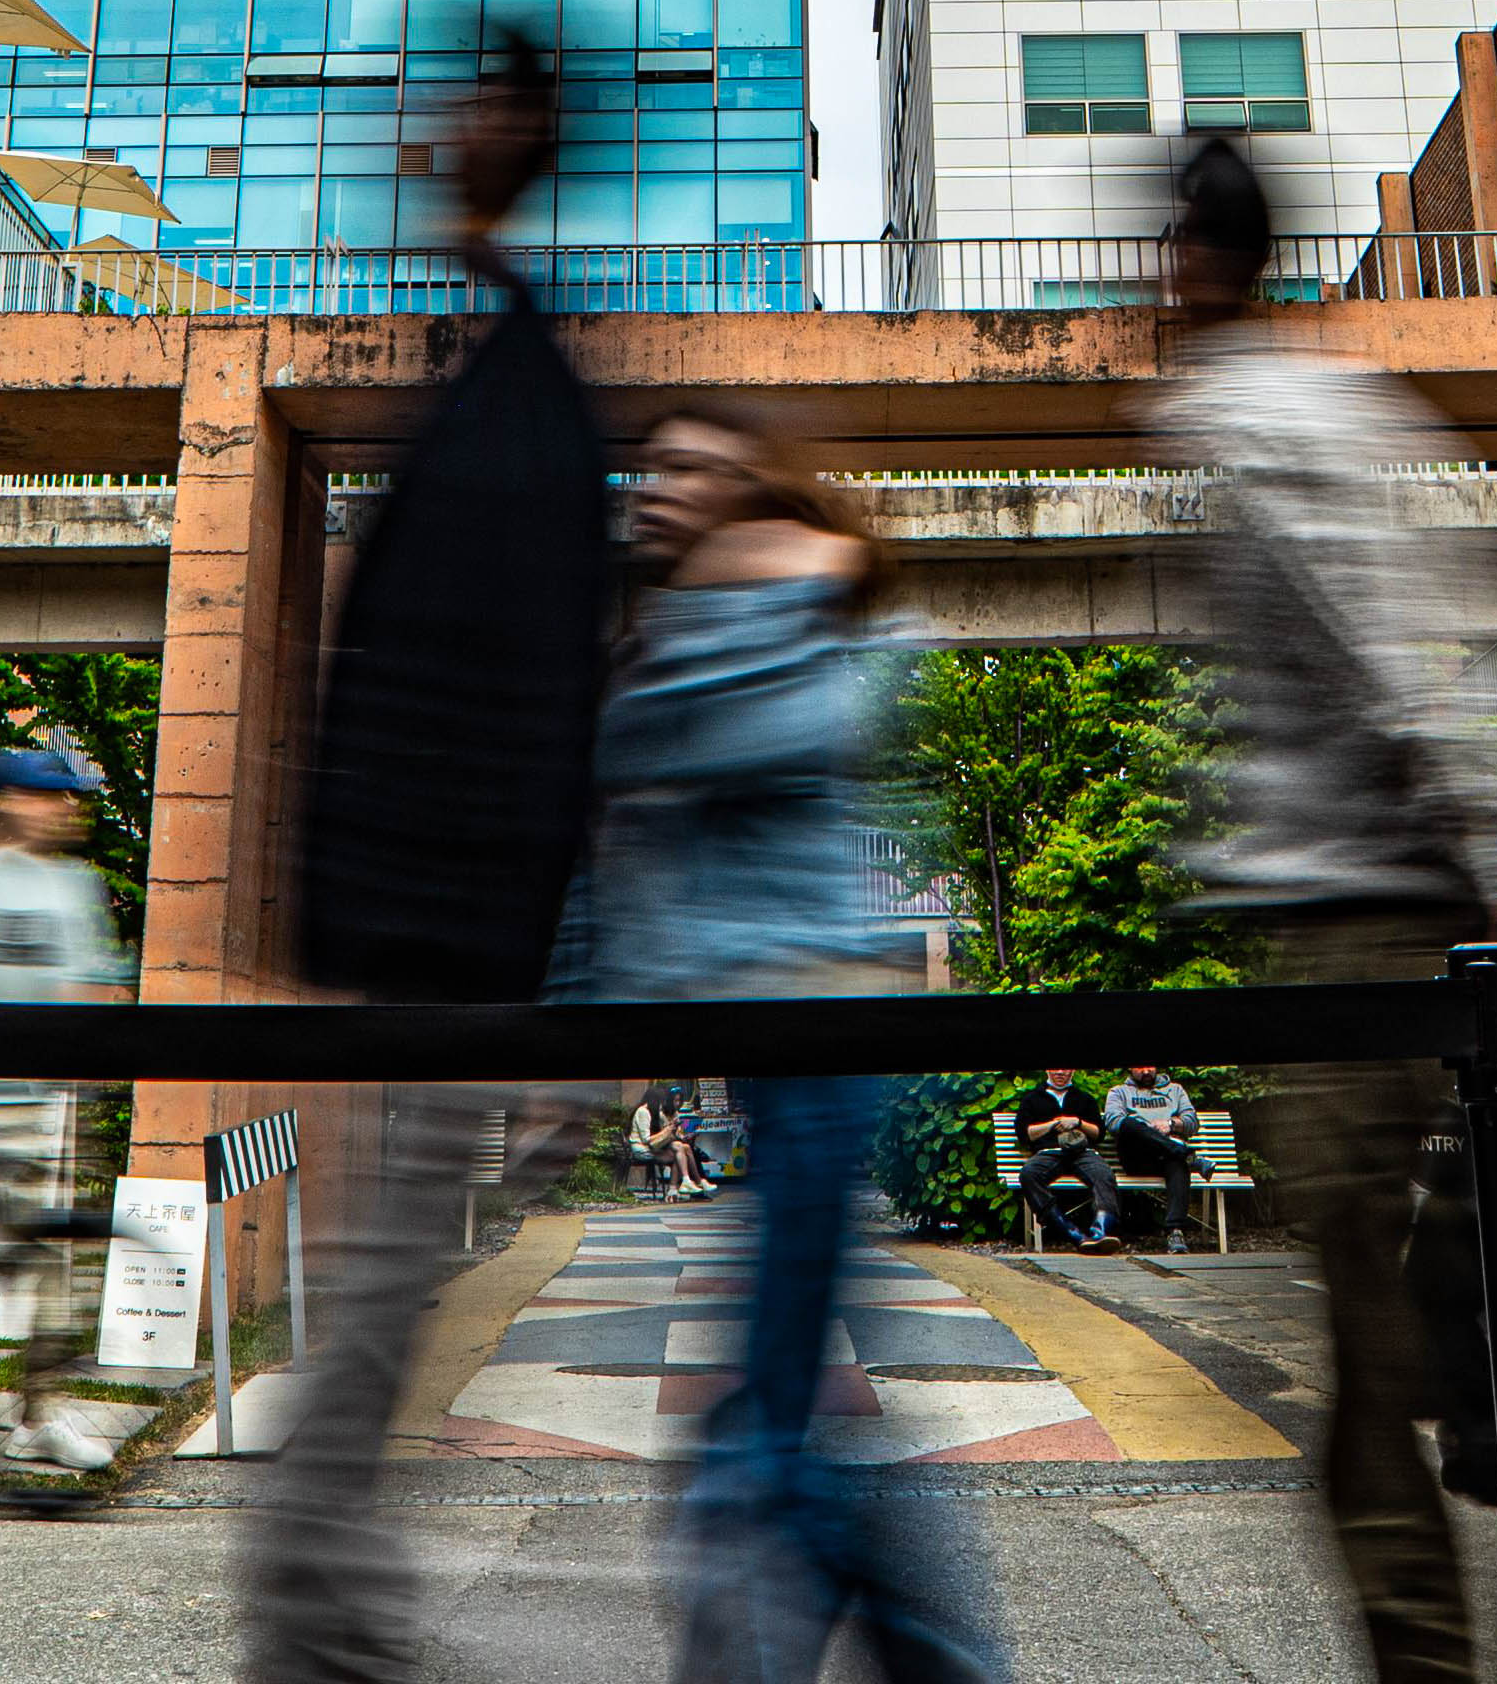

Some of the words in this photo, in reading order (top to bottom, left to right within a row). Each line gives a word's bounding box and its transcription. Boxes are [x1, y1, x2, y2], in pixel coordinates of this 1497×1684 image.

[1418, 1135, 1464, 1152] NTRY
[124, 1266, 146, 1274] OPEN
[116, 1307, 143, 1317] Coffee
[145, 1308, 152, 1317] &
[154, 1309, 186, 1318] Dessert
[142, 1331, 156, 1342] 3F
